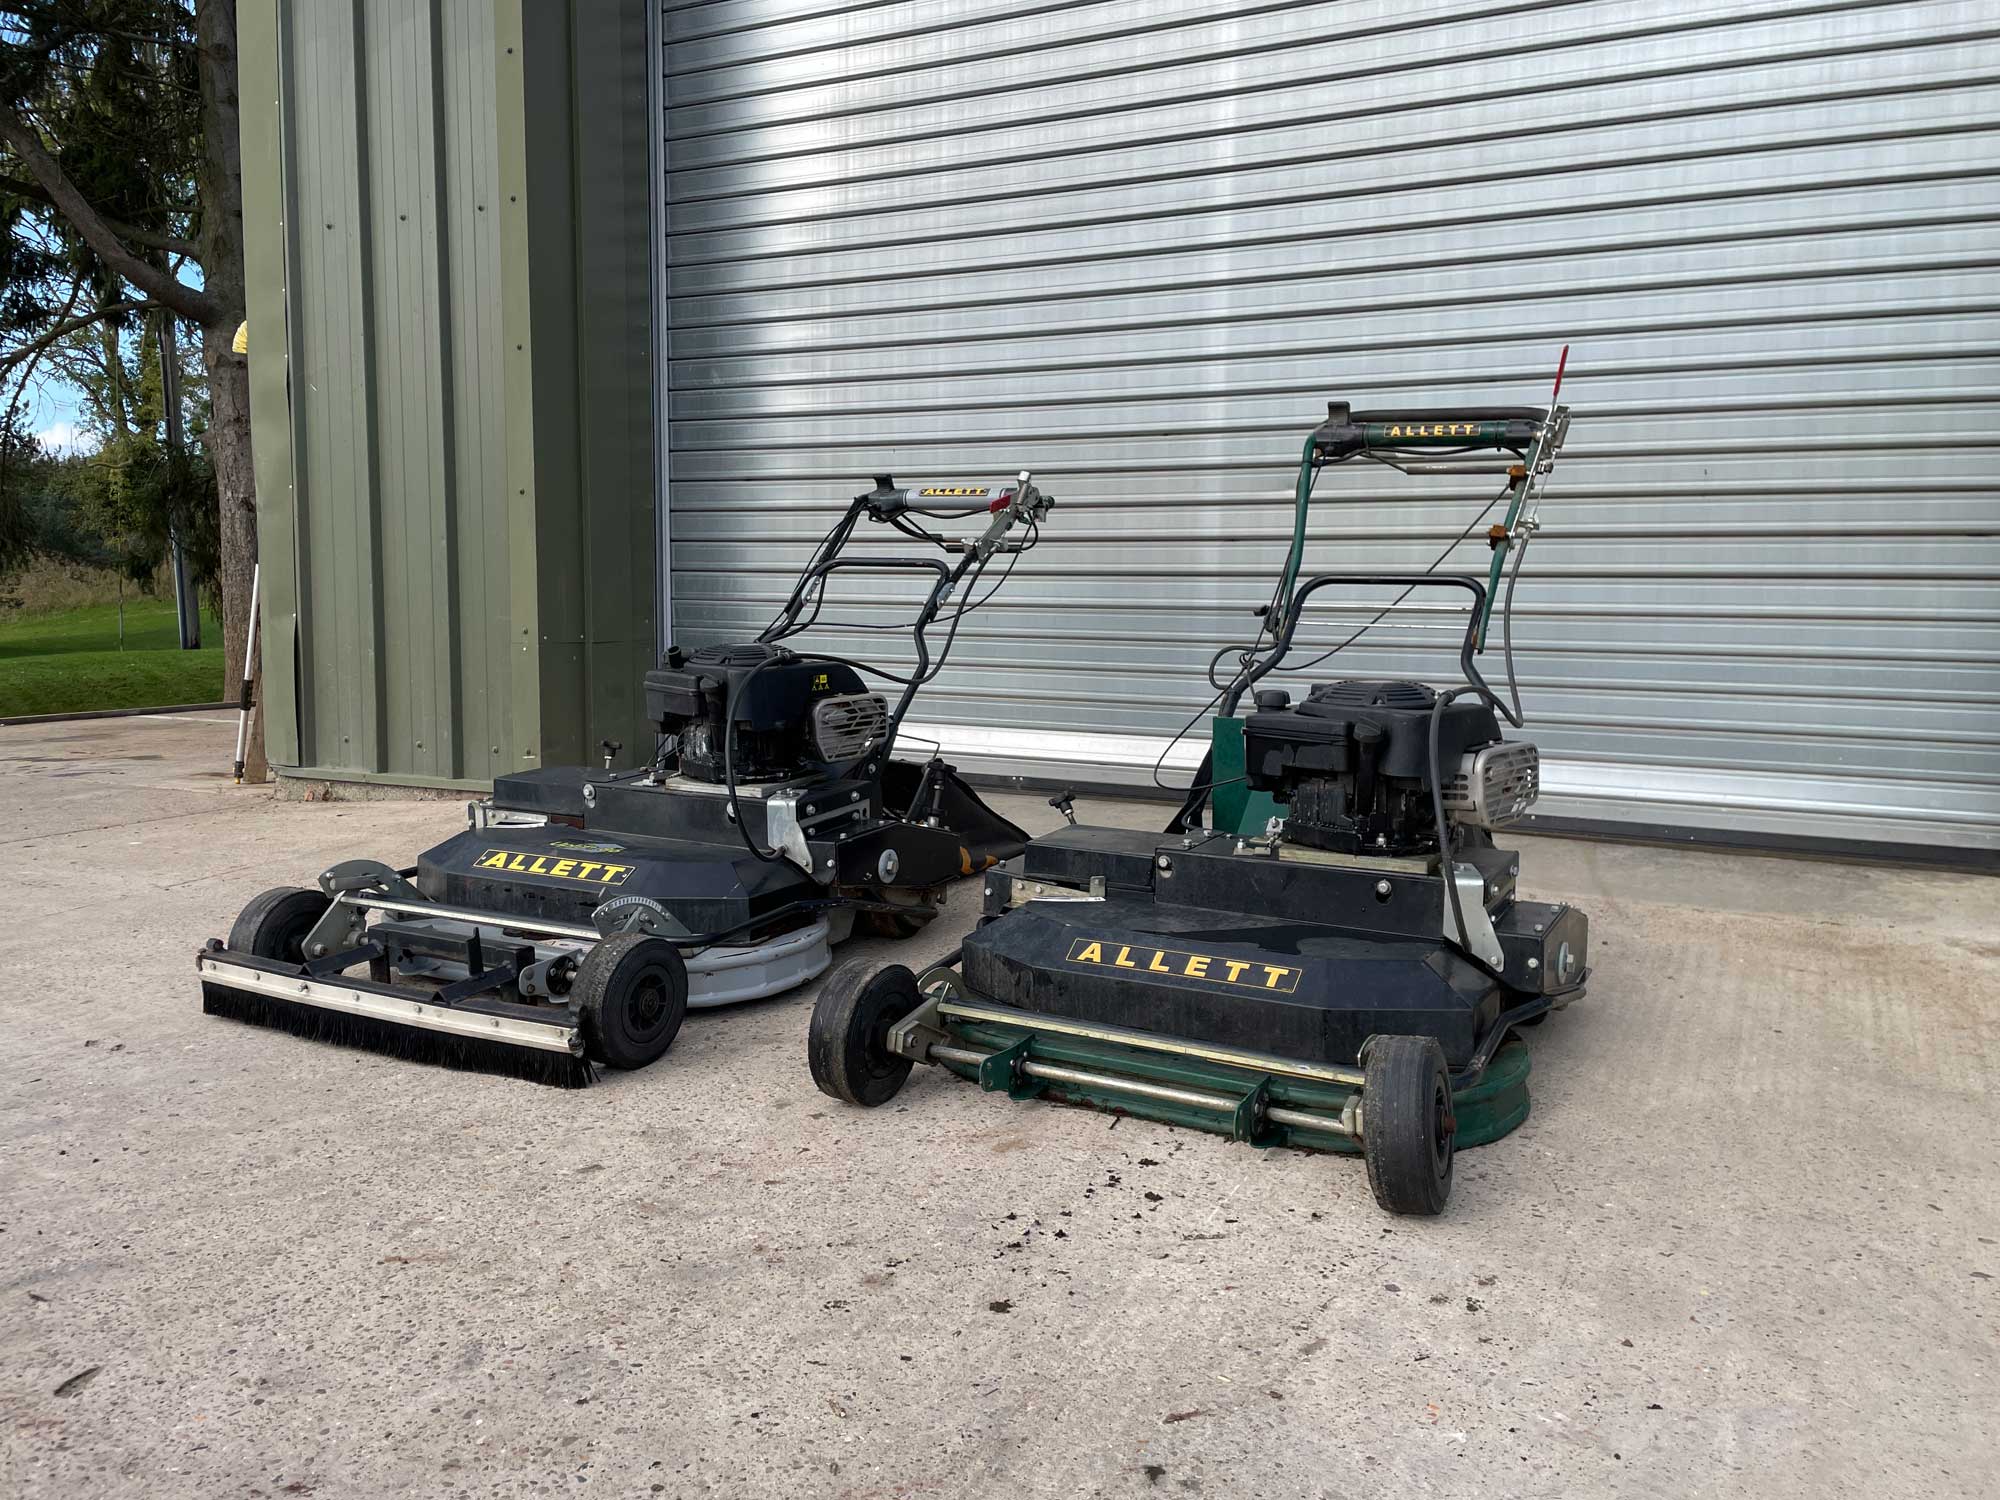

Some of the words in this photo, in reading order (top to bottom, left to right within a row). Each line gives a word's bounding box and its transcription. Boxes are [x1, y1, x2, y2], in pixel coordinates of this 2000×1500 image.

[1390, 424, 1474, 437] ALLETT
[482, 852, 625, 881] ALLETT
[1077, 942, 1289, 988] ALLETT
